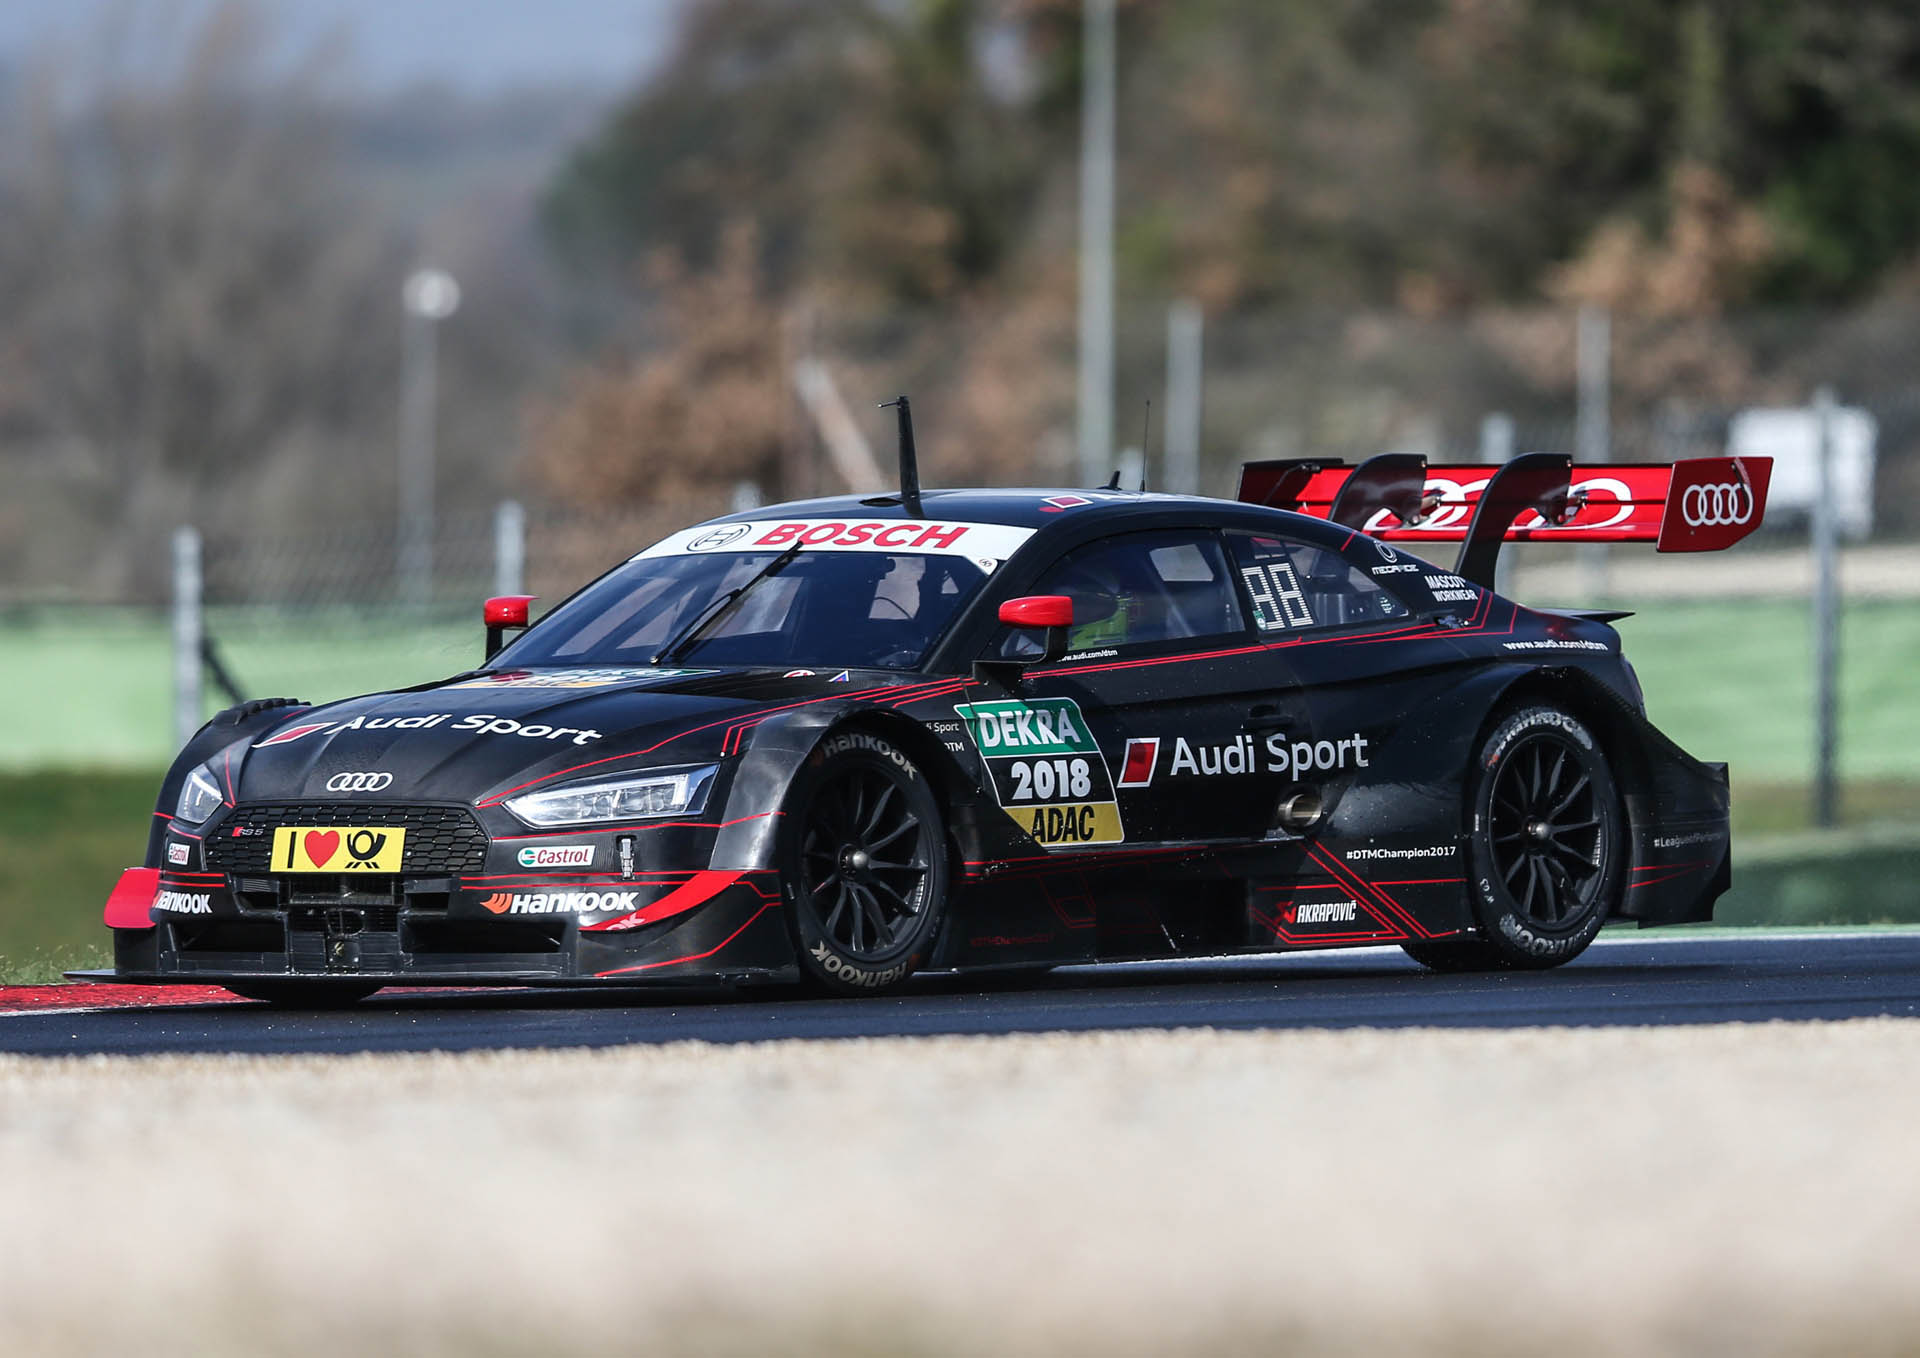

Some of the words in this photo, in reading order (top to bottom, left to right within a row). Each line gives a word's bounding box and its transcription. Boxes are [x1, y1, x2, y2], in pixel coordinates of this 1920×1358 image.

[752, 523, 970, 548] BOSCH
[1424, 575, 1466, 589] MASCOT
[1432, 589, 1479, 602] WORKWEAR
[1502, 639, 1609, 651] www.audi.com/dtm
[323, 713, 453, 736] Audi
[451, 714, 603, 745] Sport
[933, 722, 960, 734] Sport
[978, 708, 1082, 748] DEKRA
[1170, 734, 1256, 776] Audi
[1266, 733, 1369, 781] Sport
[1011, 758, 1091, 800] 2018
[1031, 805, 1096, 843] ADAC
[537, 849, 589, 865] Castrol
[1346, 846, 1456, 860] #DTMChampion2017
